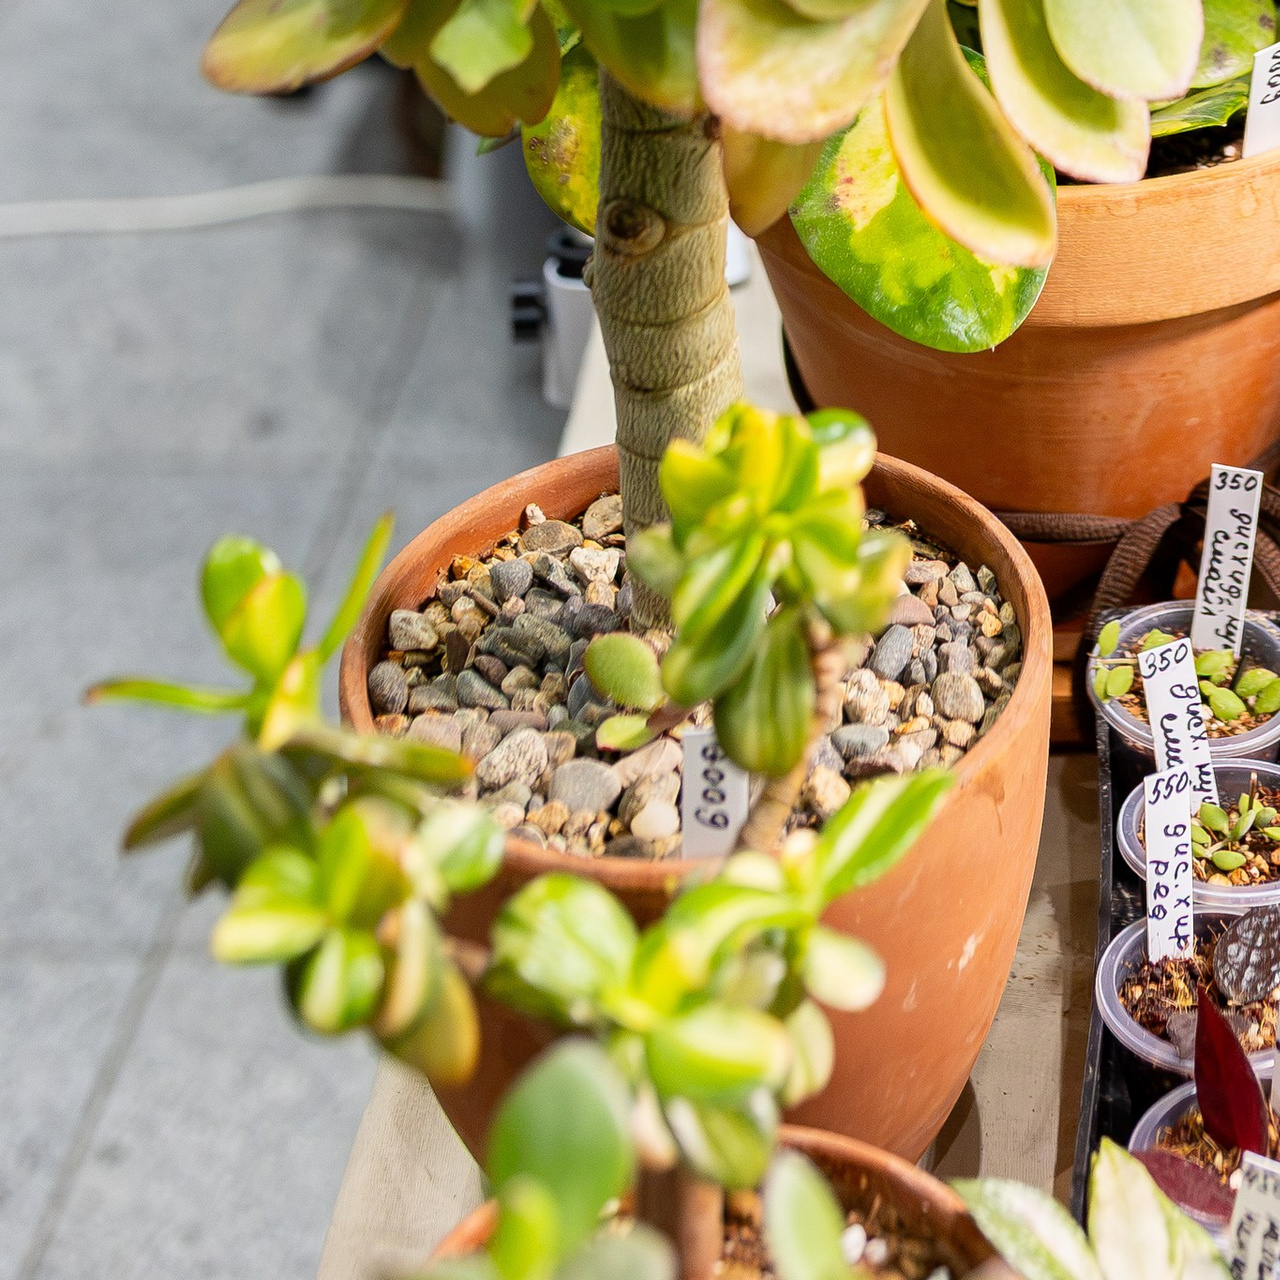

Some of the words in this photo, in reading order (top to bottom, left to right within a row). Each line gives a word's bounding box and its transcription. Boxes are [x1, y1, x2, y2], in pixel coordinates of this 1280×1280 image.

[1214, 471, 1258, 492] 350
[1140, 643, 1189, 679] 350
[1147, 771, 1189, 806] 550
